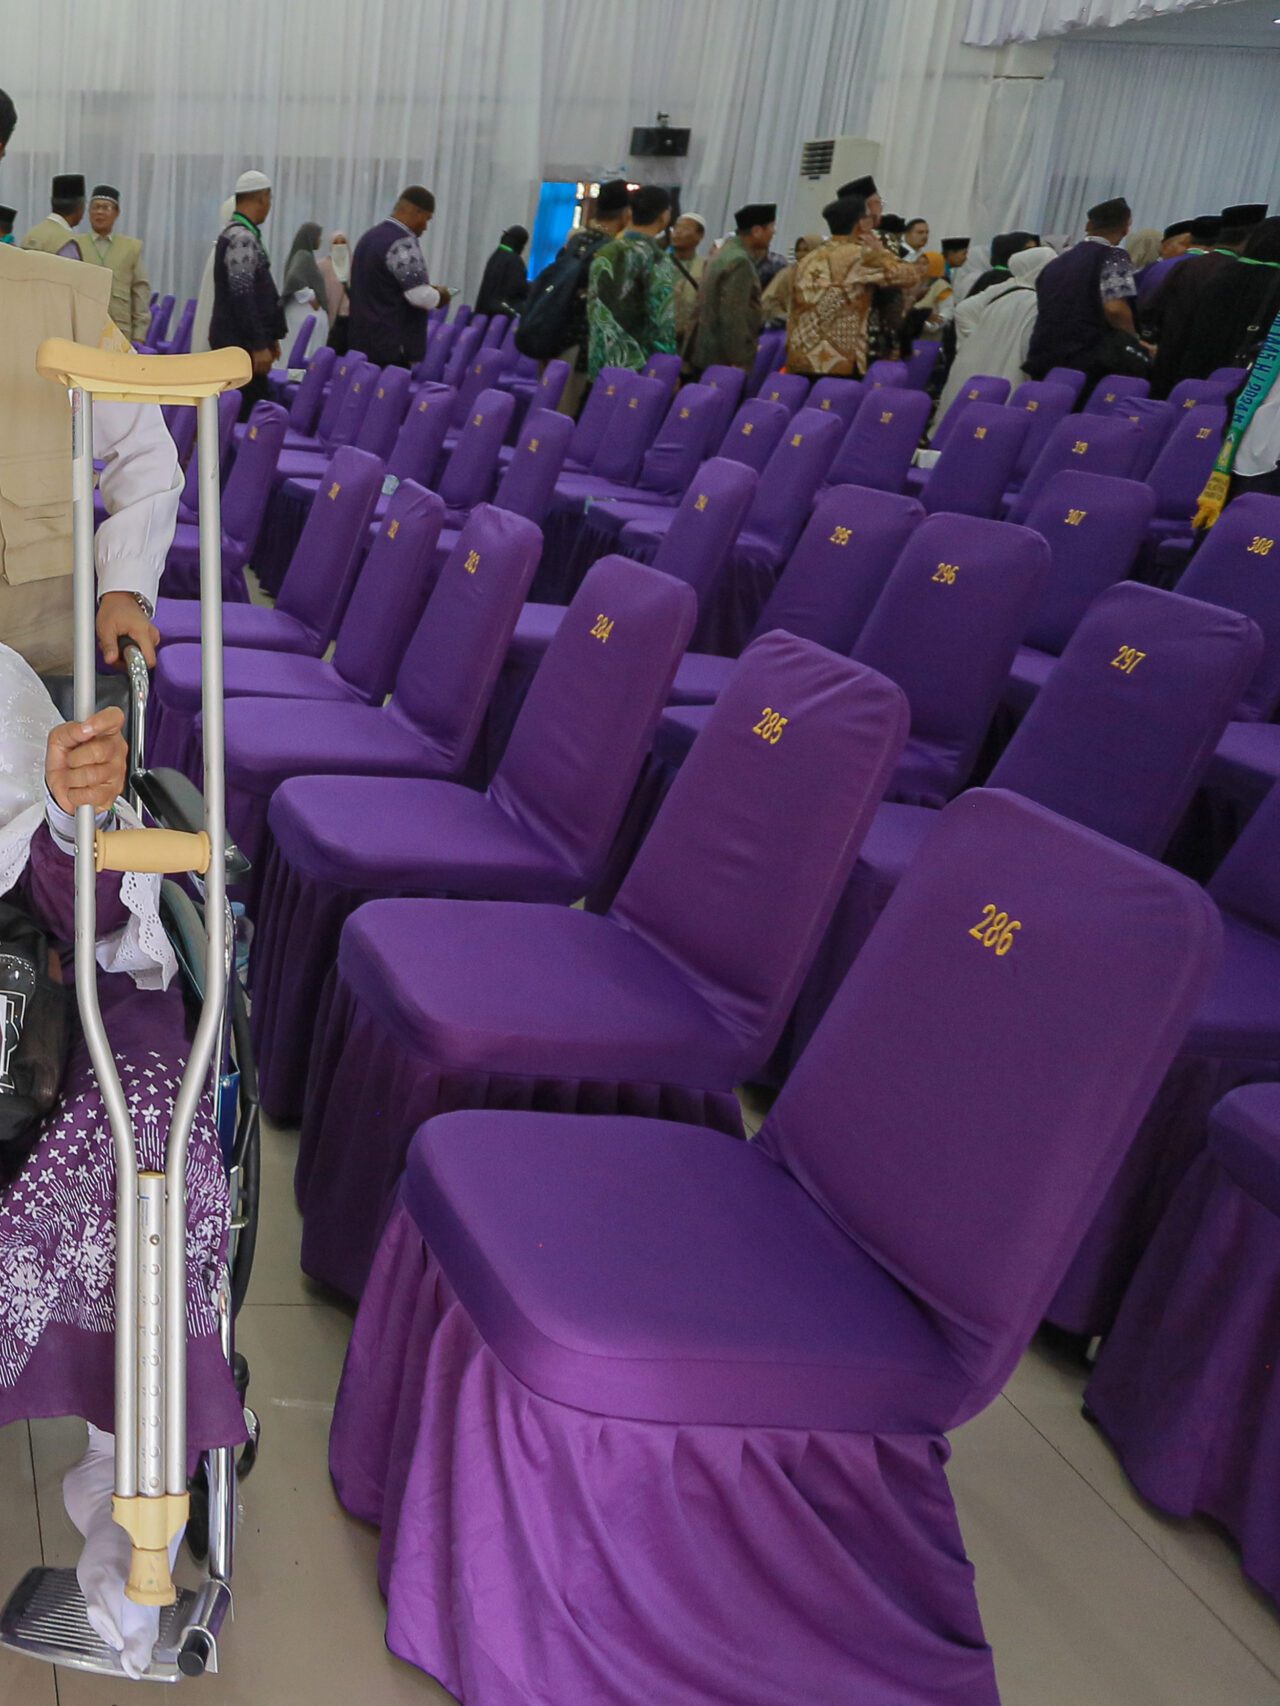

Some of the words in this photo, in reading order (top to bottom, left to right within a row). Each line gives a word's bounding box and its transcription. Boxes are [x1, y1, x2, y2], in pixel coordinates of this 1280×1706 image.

[1247, 536, 1275, 556] 308
[931, 563, 960, 585] 296
[589, 614, 615, 643] 284
[1110, 644, 1146, 674] 297
[752, 707, 789, 745] 285
[969, 904, 1022, 956] 286
